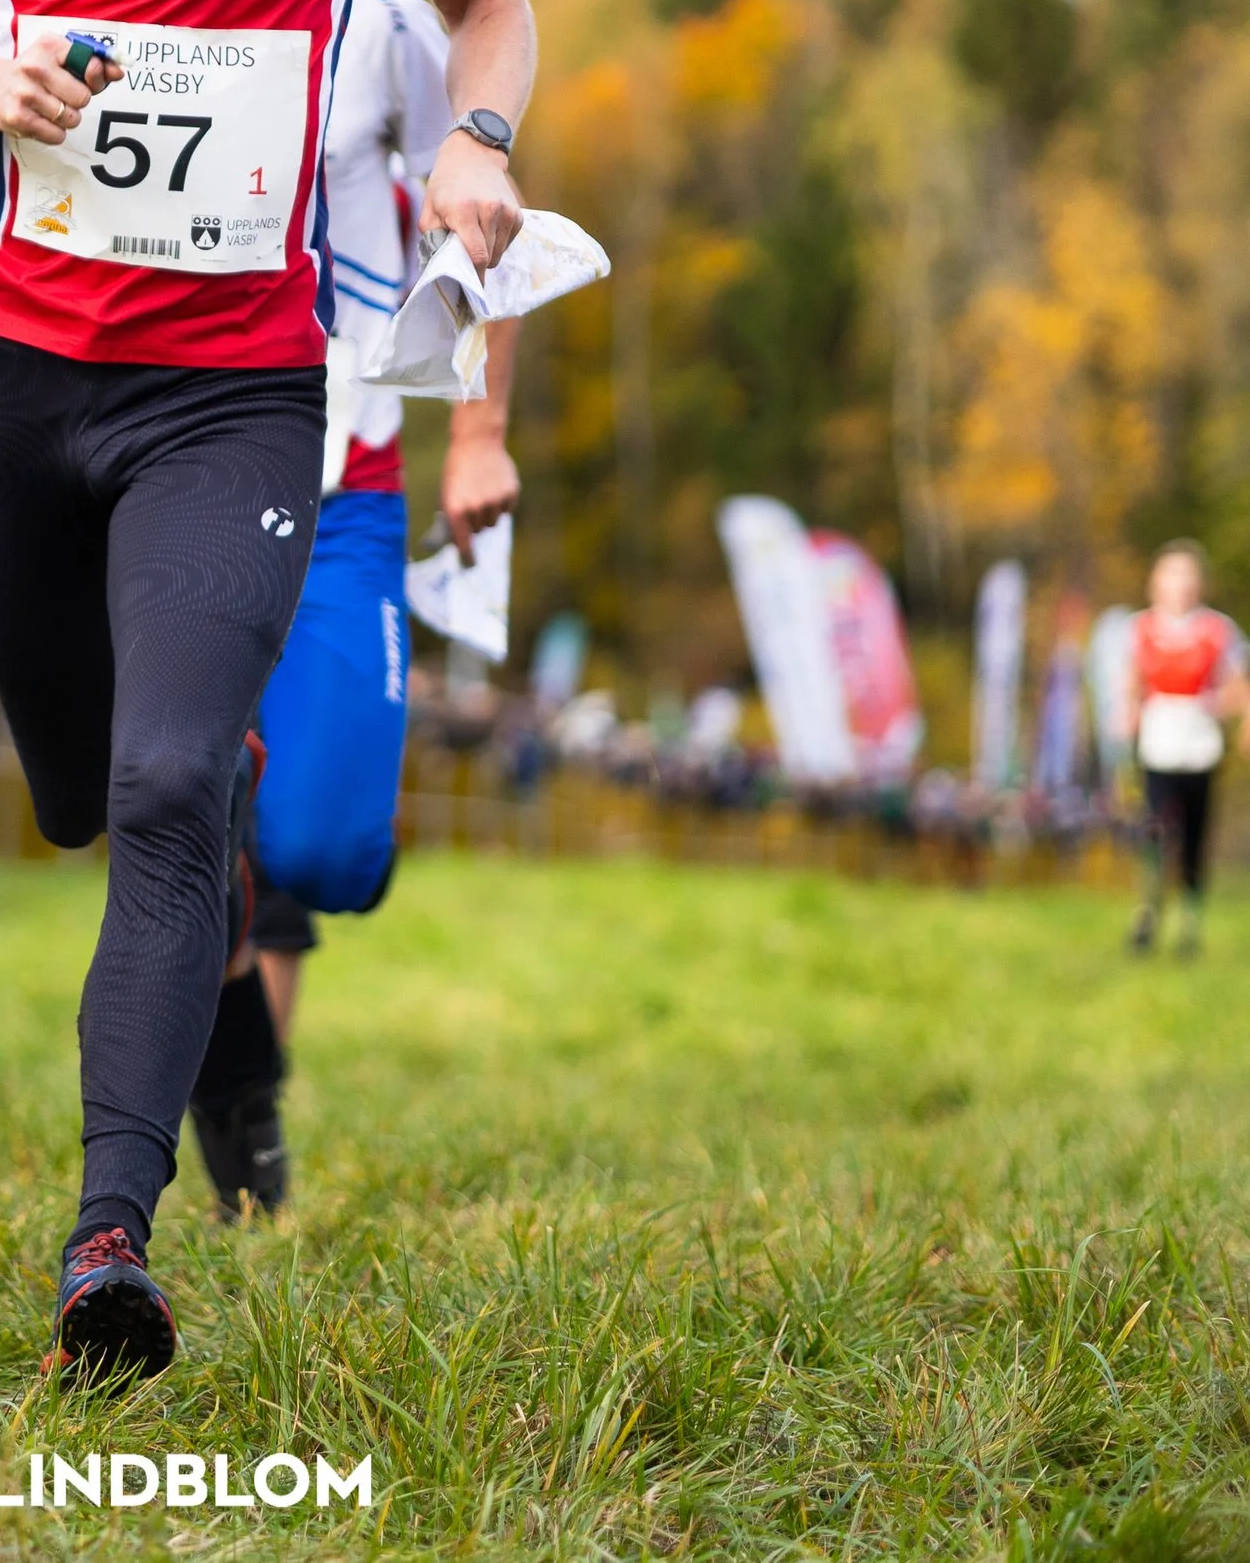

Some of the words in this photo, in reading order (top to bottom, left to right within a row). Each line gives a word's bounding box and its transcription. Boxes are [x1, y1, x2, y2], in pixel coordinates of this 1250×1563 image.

[127, 40, 256, 68] UPPLANDS
[127, 67, 205, 94] VÄSBY
[90, 109, 213, 192] 57
[248, 166, 268, 195] 1
[226, 217, 282, 232] UPPLANDS
[226, 232, 259, 246] VÄSBY
